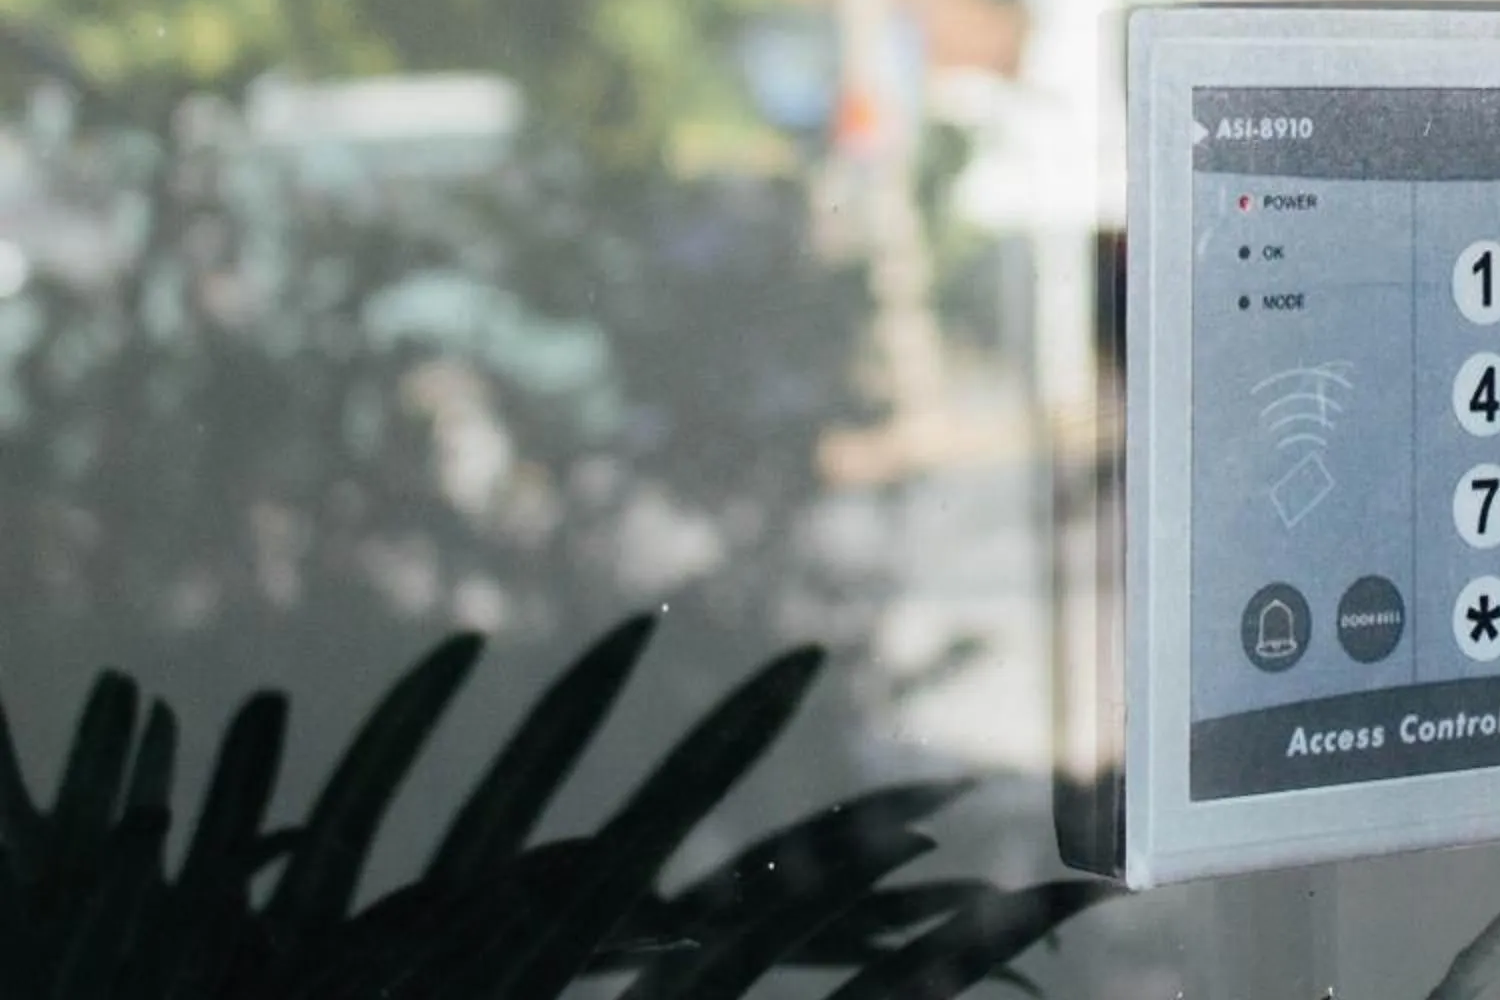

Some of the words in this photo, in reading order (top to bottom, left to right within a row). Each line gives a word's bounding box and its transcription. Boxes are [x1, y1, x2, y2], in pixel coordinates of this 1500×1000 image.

[1215, 117, 1314, 139] ASI-8910
[1263, 194, 1317, 210] POWER
[1263, 245, 1284, 260] OK
[1472, 250, 1493, 308] 1
[1263, 294, 1304, 309] MODE
[1469, 365, 1500, 422] 4
[1471, 477, 1500, 535] 7
[1286, 726, 1386, 757] Access
